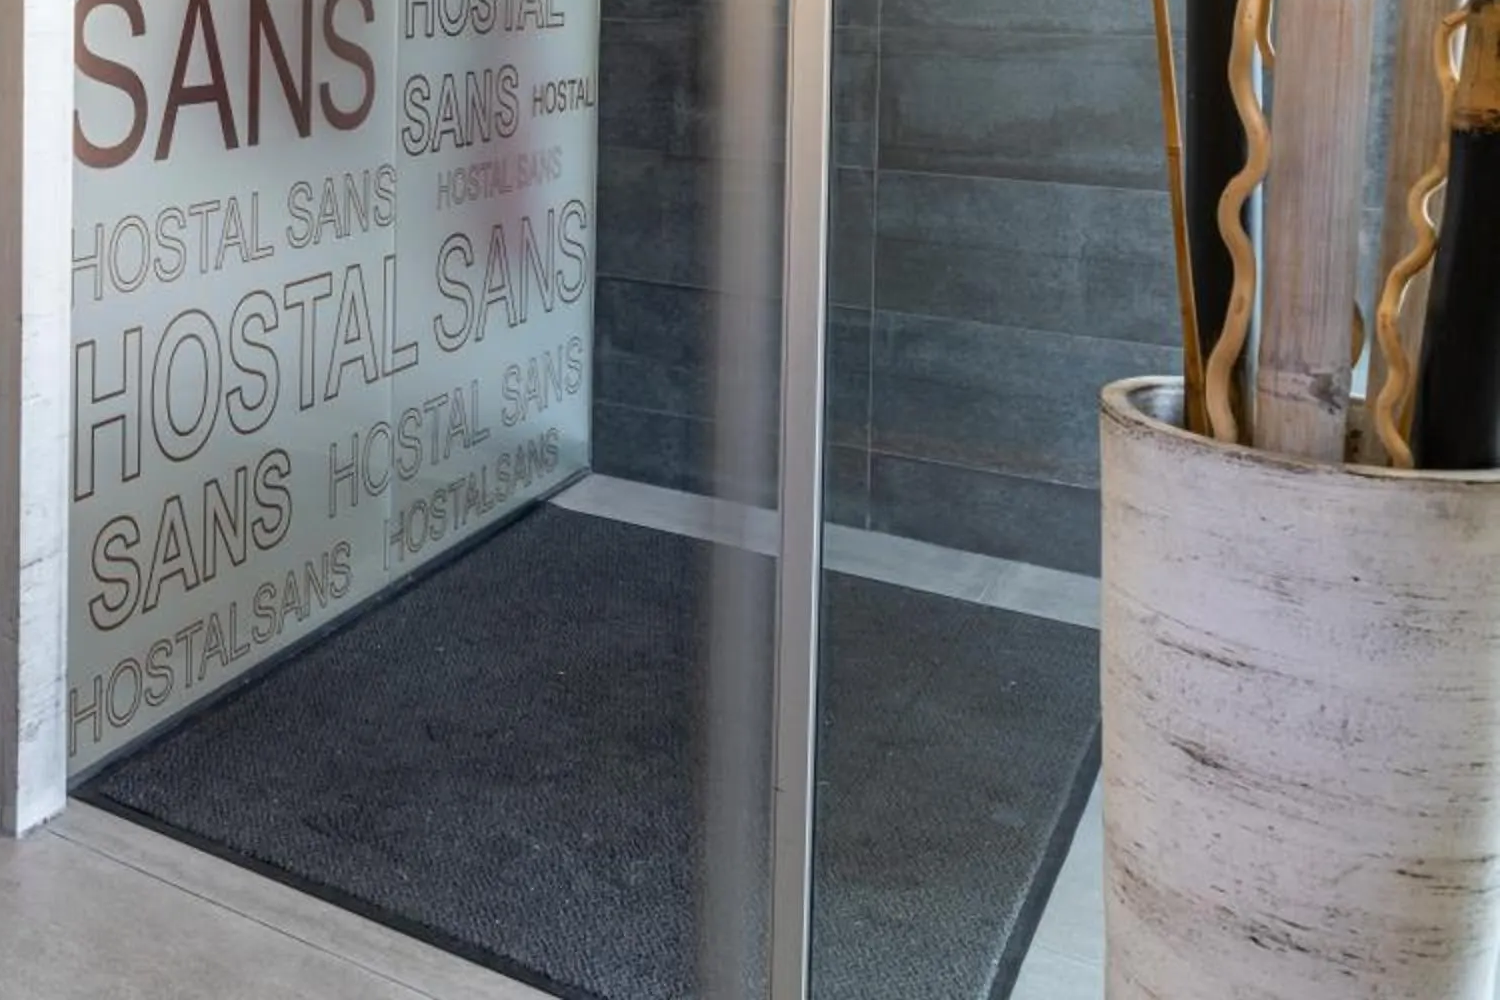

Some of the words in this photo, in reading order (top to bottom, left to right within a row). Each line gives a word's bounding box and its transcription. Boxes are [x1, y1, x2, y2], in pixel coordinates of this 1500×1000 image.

[401, 64, 519, 157] SANS
[532, 76, 596, 117] HOSTAL
[72, 191, 274, 307] HOSTAL
[285, 163, 397, 250] SANS
[436, 160, 513, 211] HOSTAL
[74, 254, 418, 502] HOSTAL
[433, 199, 588, 353] SANS
[328, 379, 491, 519] HOSTAL
[501, 335, 583, 428] SANS
[88, 448, 292, 632] SANS
